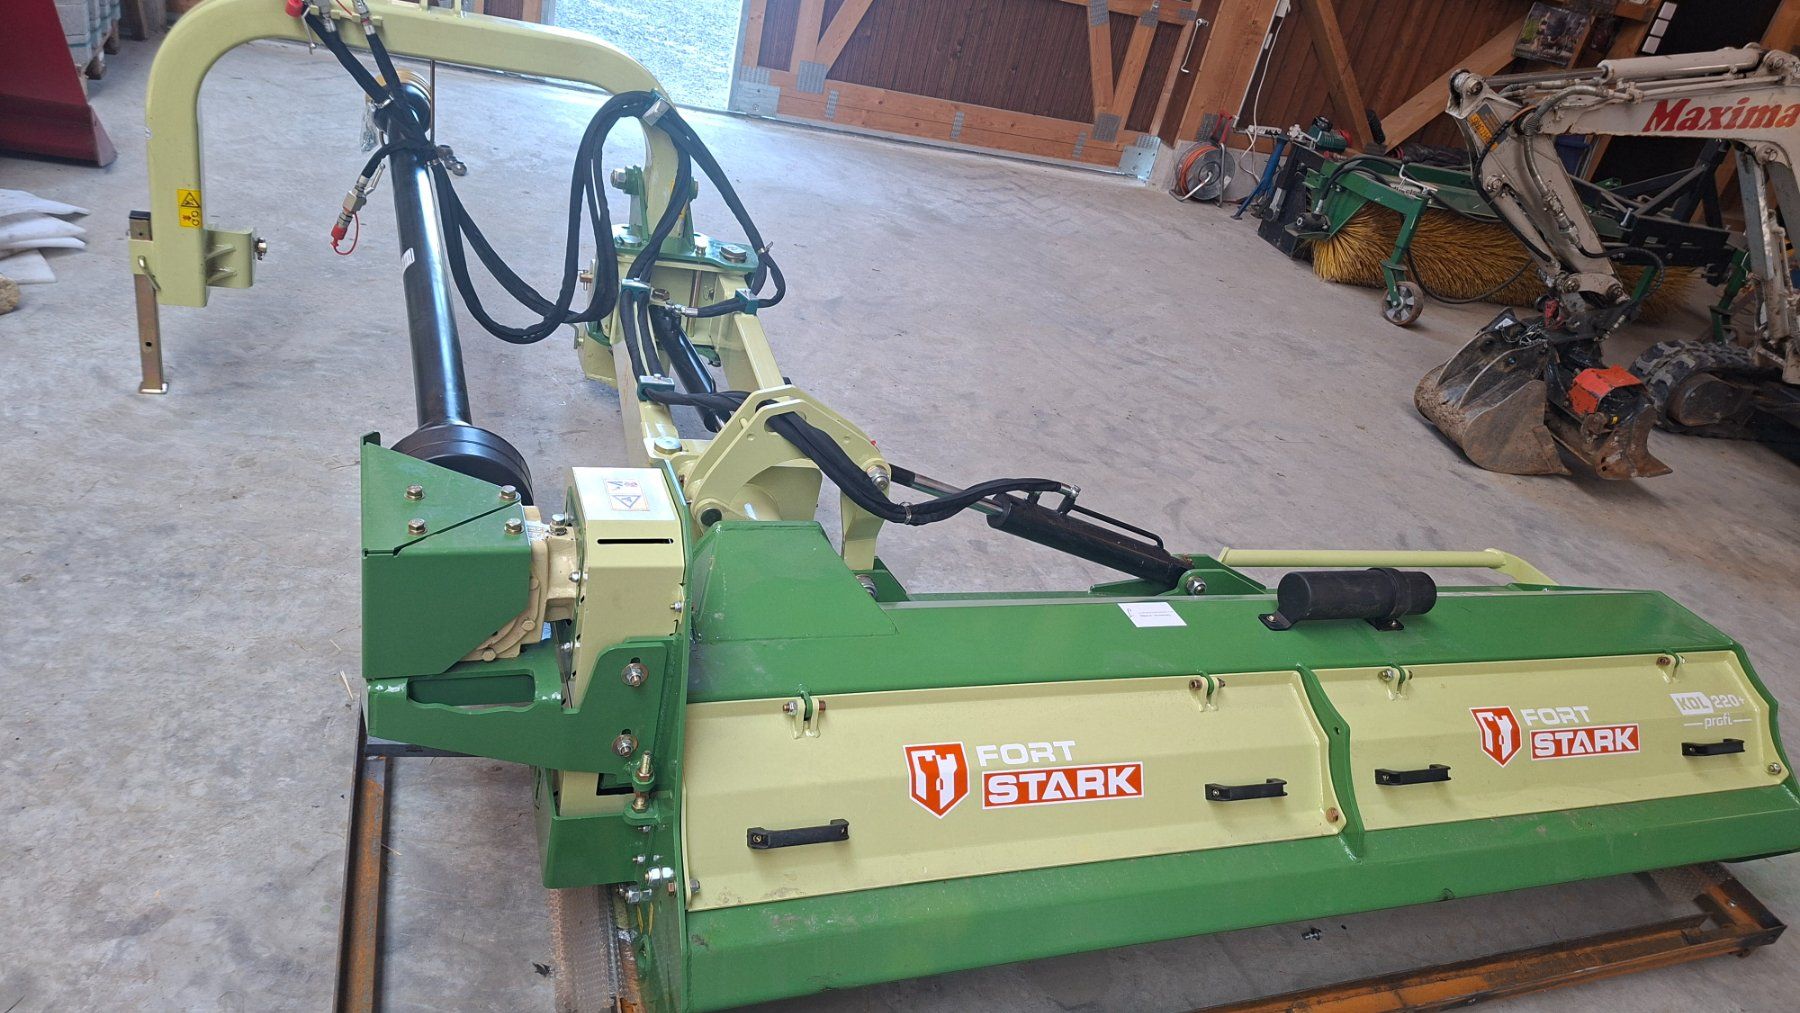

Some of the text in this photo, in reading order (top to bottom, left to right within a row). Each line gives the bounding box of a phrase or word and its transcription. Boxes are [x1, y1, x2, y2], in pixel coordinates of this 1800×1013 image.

[1642, 97, 1800, 132] Maxima
[1520, 706, 1590, 726] FORT
[1675, 694, 1745, 711] KDL 220+
[1704, 712, 1733, 729] profi
[975, 740, 1076, 767] FORT
[1533, 727, 1636, 757] STARK
[988, 767, 1138, 804] STARK
